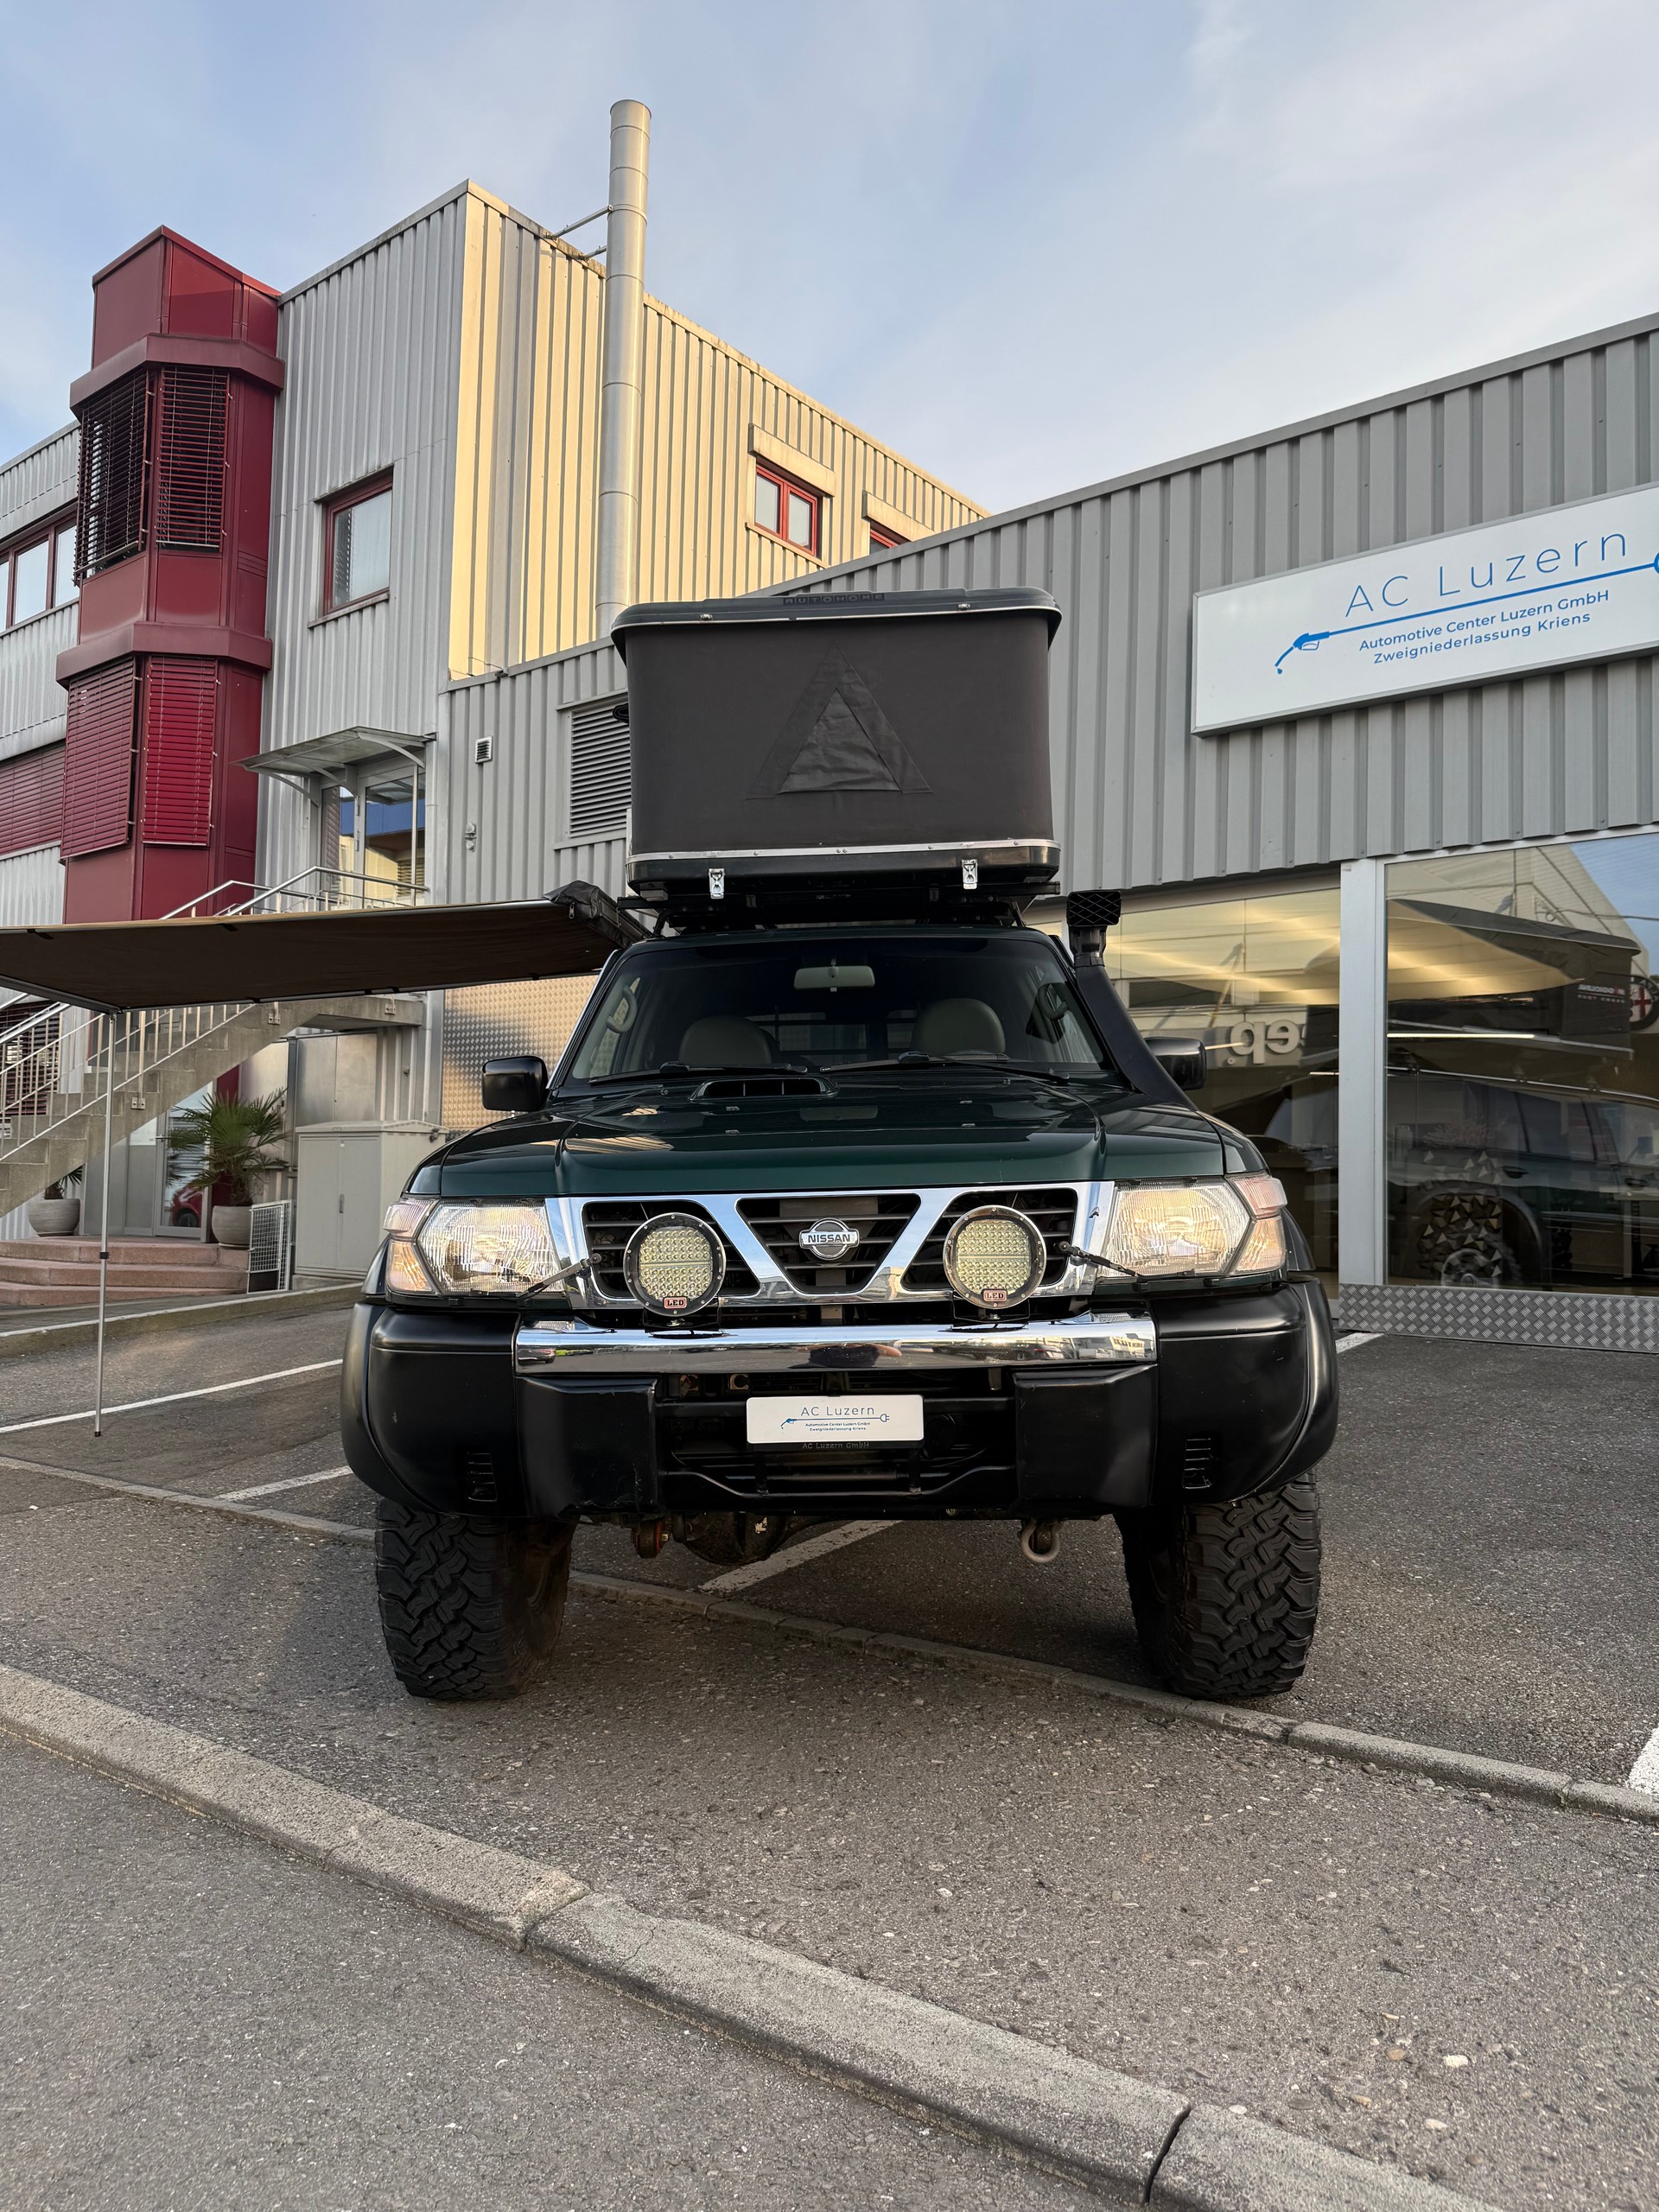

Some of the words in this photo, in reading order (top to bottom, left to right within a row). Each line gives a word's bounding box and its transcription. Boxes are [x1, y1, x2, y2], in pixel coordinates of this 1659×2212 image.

[1345, 575, 1408, 618] AC
[1440, 533, 1625, 597] Luzern
[785, 594, 883, 605] AUTOHOME
[1359, 626, 1442, 651] Automotive
[1446, 615, 1496, 632] Center
[1501, 603, 1553, 622] Luzern
[1558, 589, 1609, 610] GmbH
[1374, 625, 1531, 664] Zweigniederlassung
[1538, 613, 1591, 632] Kriens
[808, 1234, 851, 1243] NISSAN
[801, 1407, 819, 1416] AC
[826, 1406, 874, 1416] Luzern
